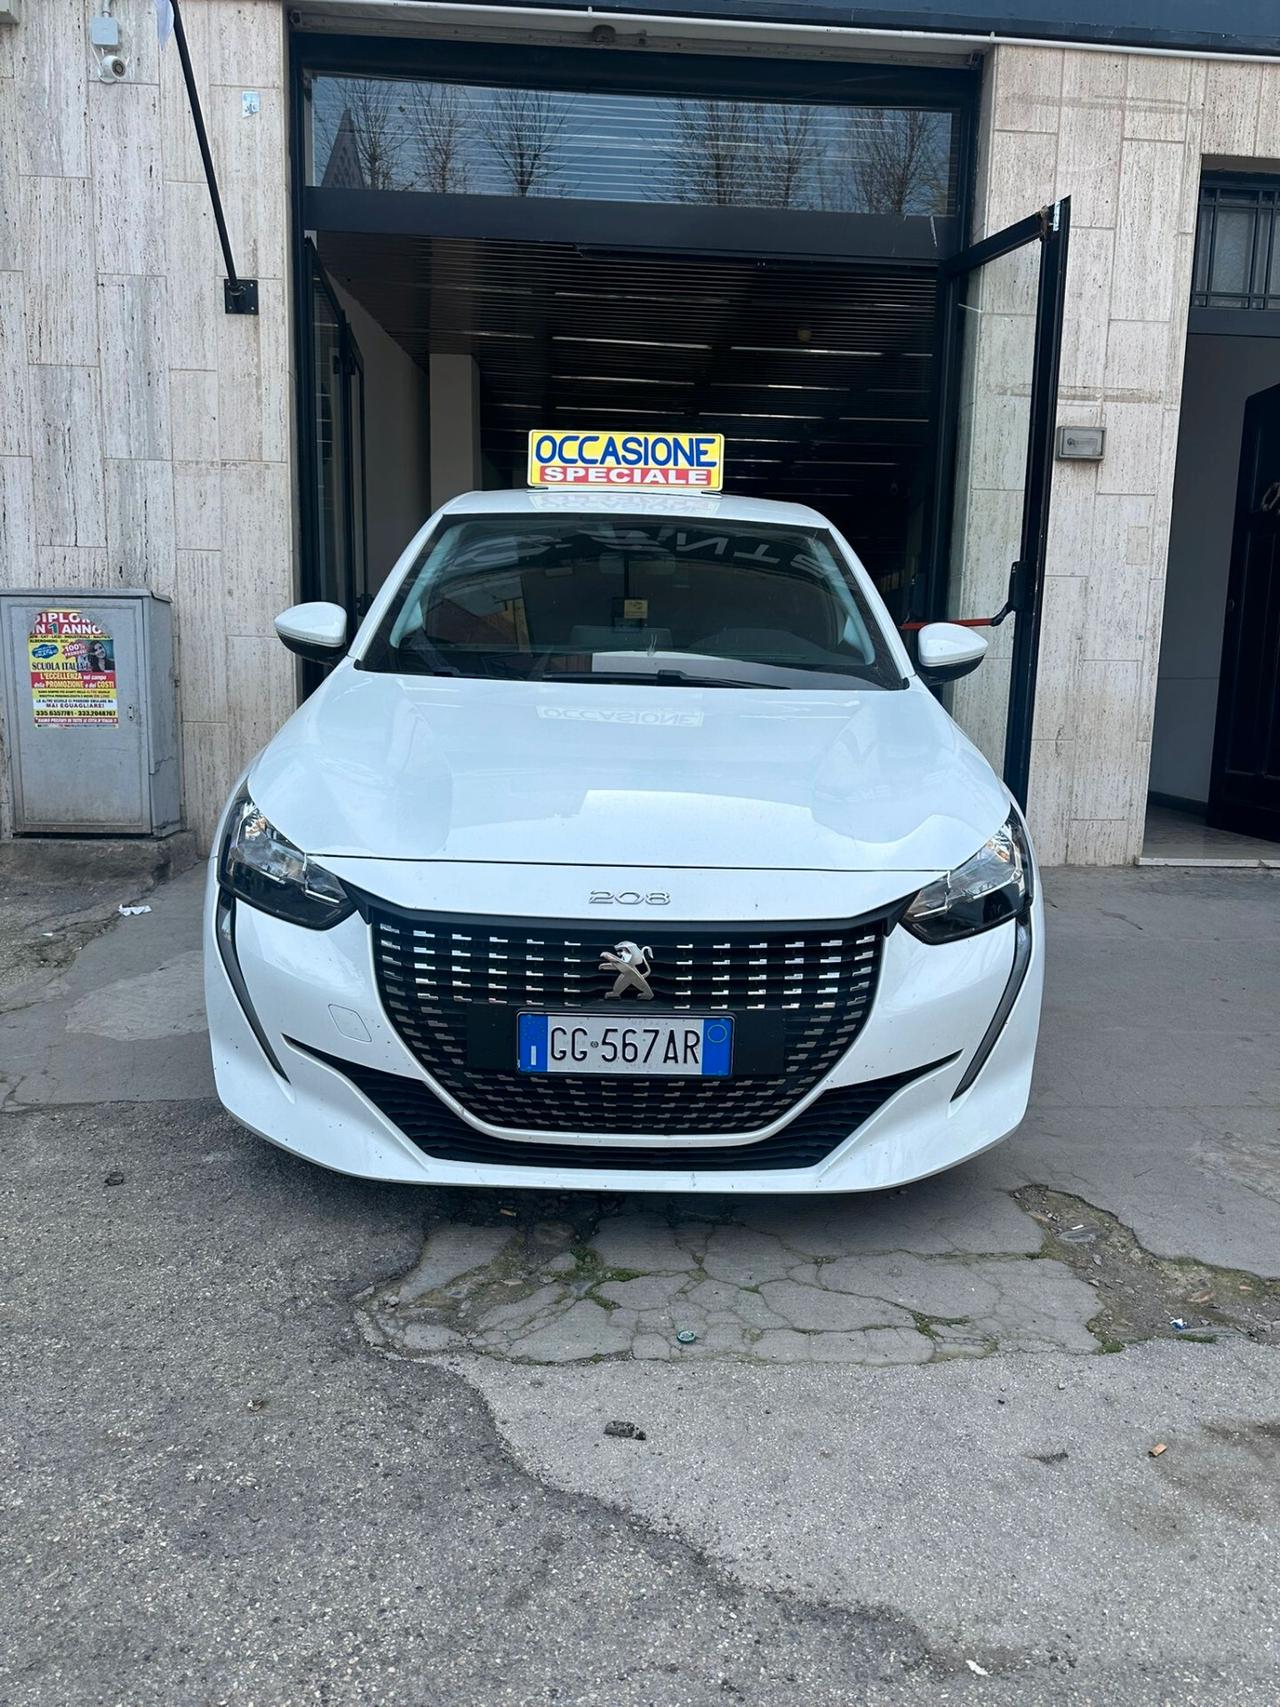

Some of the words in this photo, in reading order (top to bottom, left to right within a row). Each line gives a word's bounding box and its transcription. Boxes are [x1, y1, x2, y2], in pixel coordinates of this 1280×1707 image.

[535, 434, 718, 468] OCCASIONE
[543, 467, 709, 485] SPECIALE
[62, 624, 102, 634] ANNO
[31, 662, 60, 670] SCUOLA
[589, 891, 671, 905] 208
[551, 1027, 588, 1062] GG
[600, 1028, 701, 1064] 567AR
